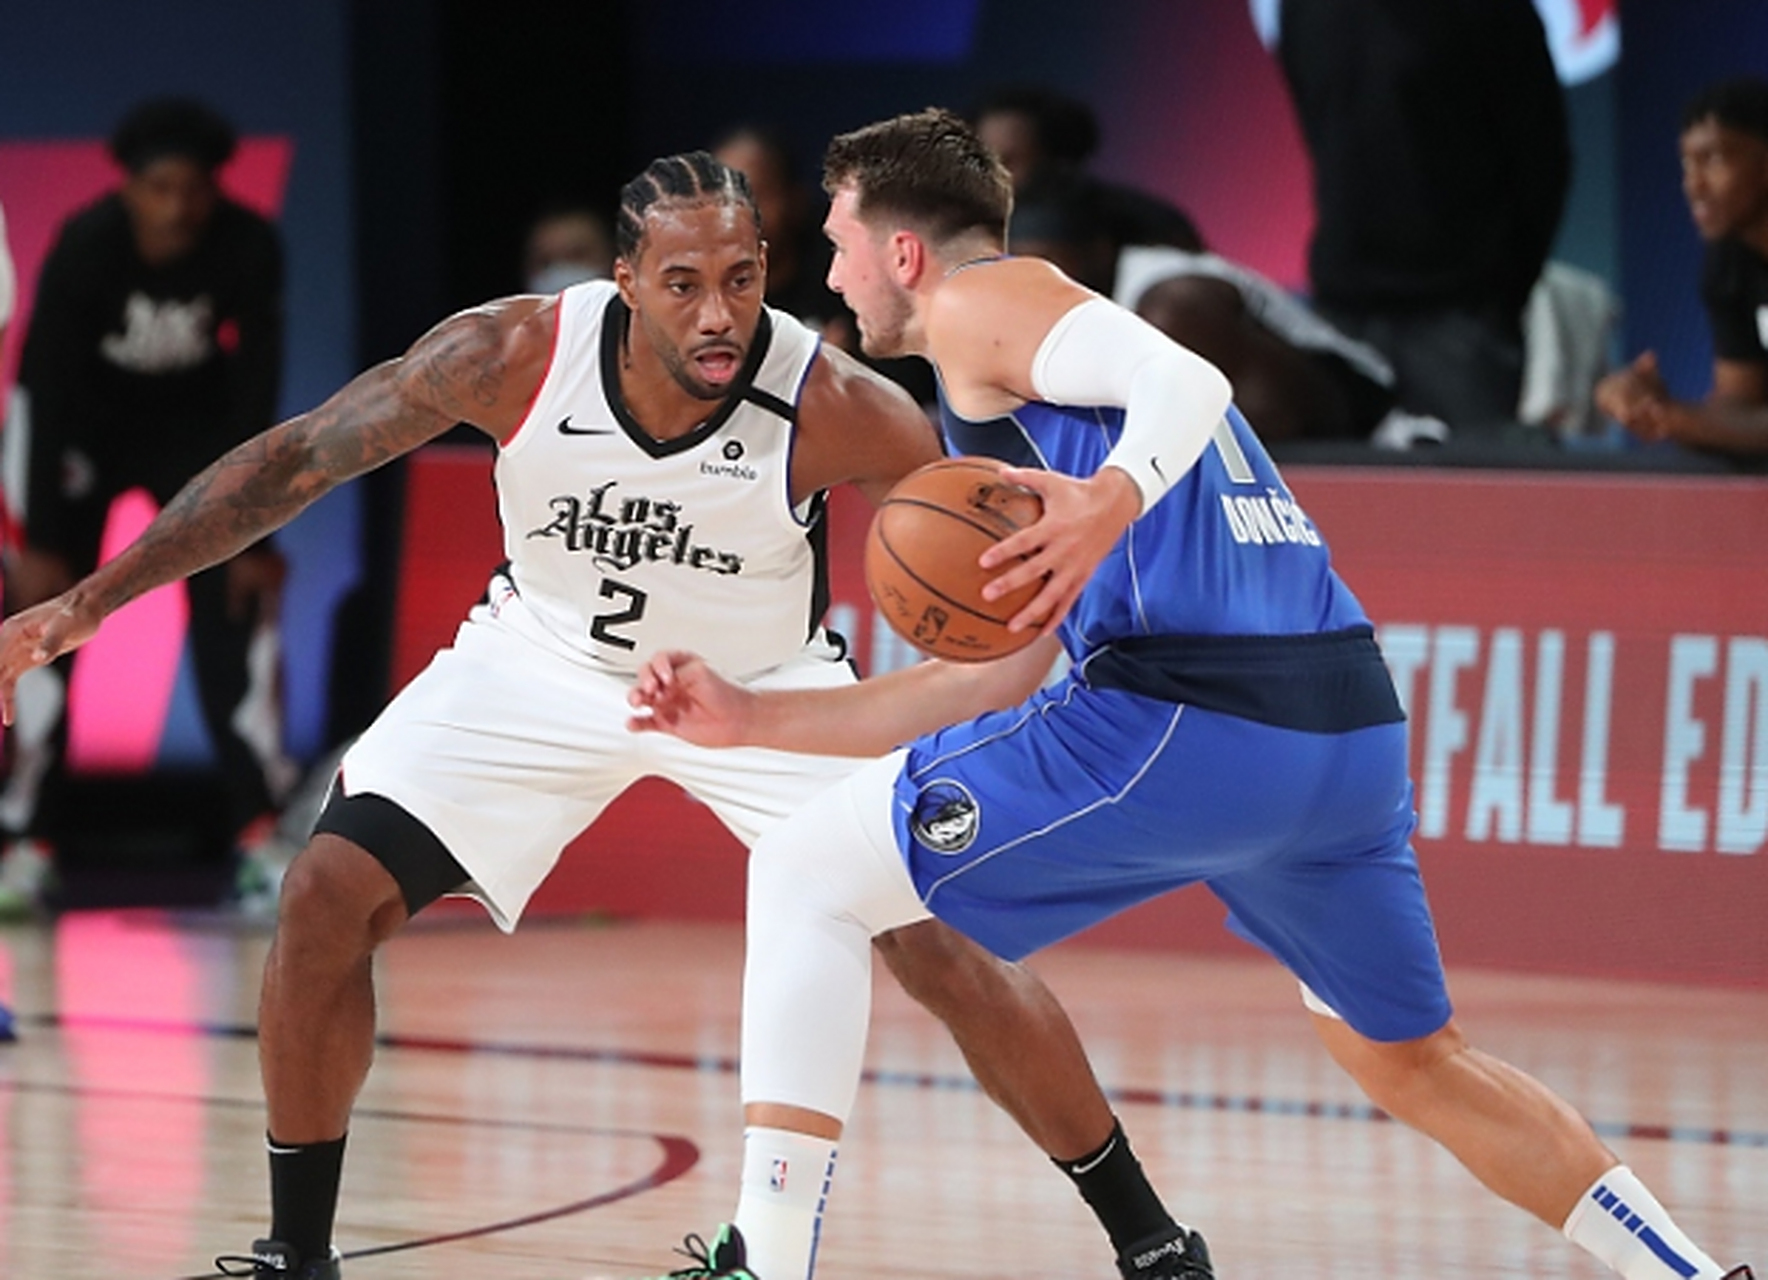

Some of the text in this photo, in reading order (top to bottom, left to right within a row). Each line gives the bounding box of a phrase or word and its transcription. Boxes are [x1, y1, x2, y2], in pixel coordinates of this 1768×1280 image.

[526, 496, 744, 574] Angeles
[582, 481, 682, 532] Los
[590, 577, 648, 651] 2
